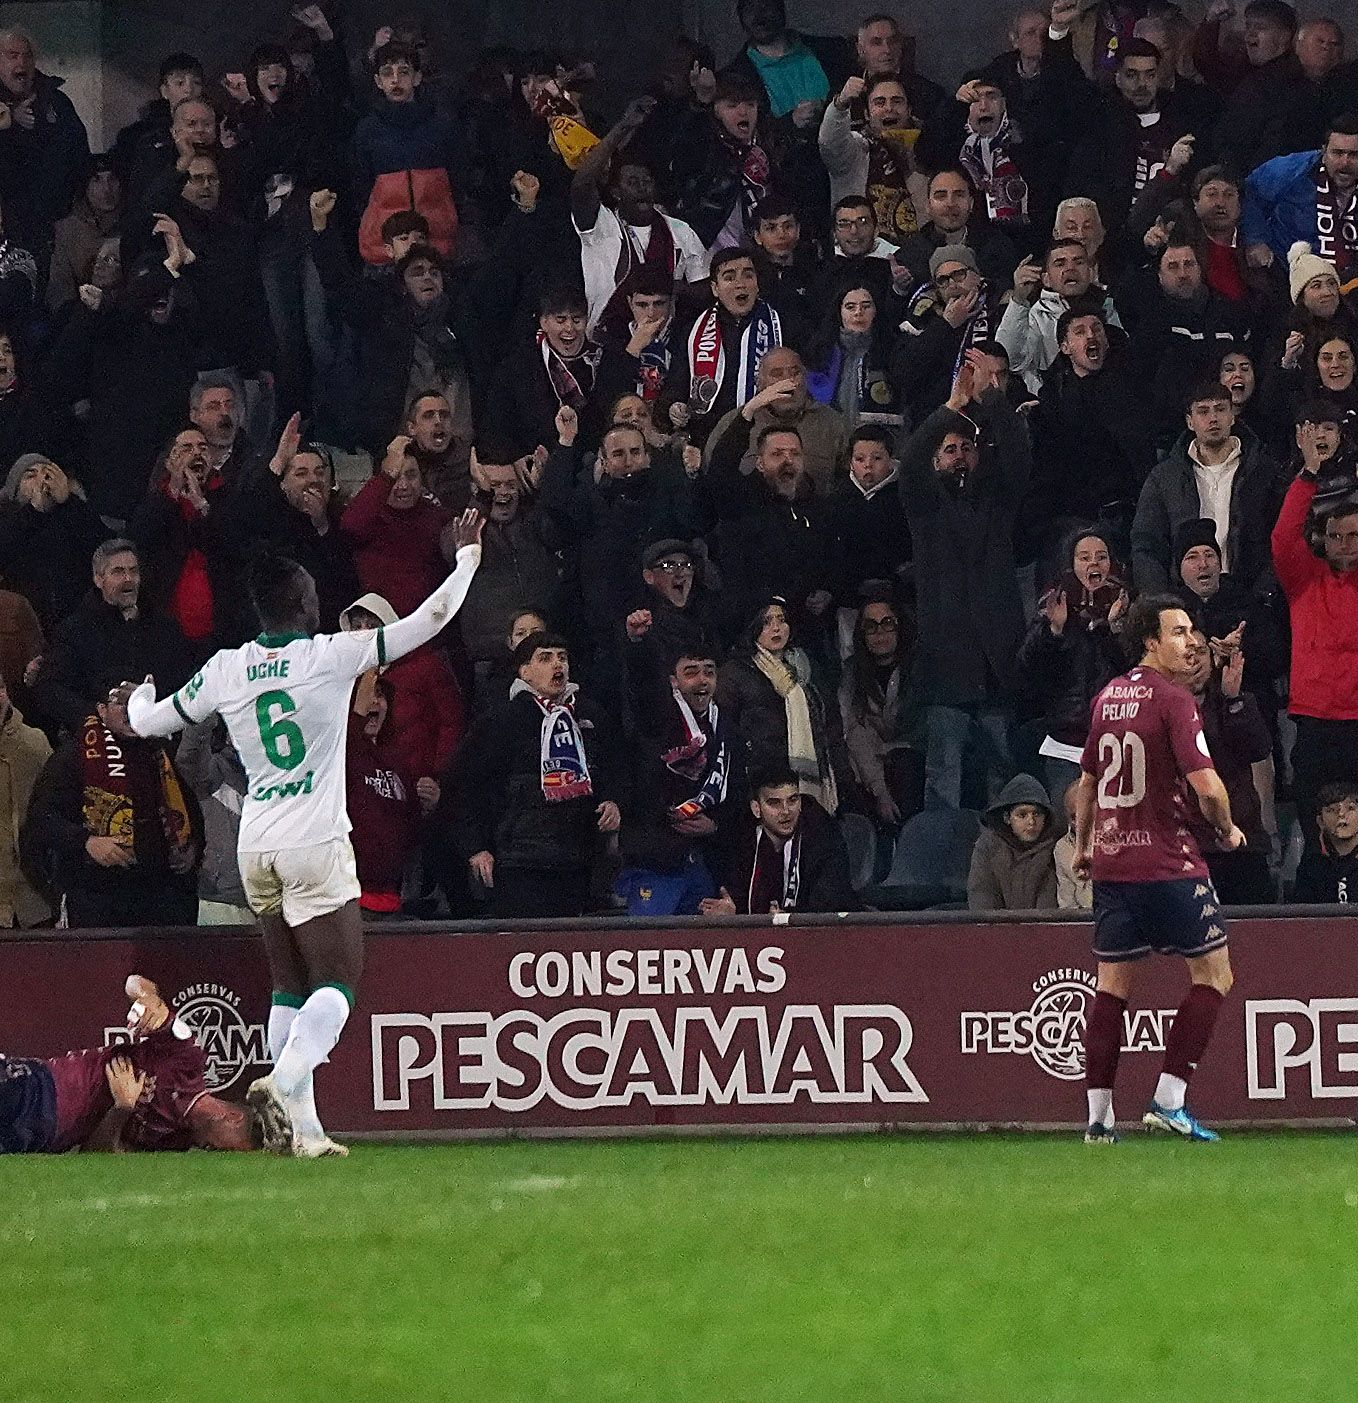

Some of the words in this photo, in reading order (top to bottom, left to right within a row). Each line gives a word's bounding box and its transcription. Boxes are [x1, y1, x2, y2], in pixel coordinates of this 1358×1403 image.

[256, 689, 306, 771] 6
[1097, 731, 1147, 810] 20
[172, 983, 242, 1008] CONSERVAS
[508, 946, 787, 999] CONSERVAS
[1032, 967, 1098, 993] CONSERVA
[370, 1004, 930, 1112] PESCAMAR
